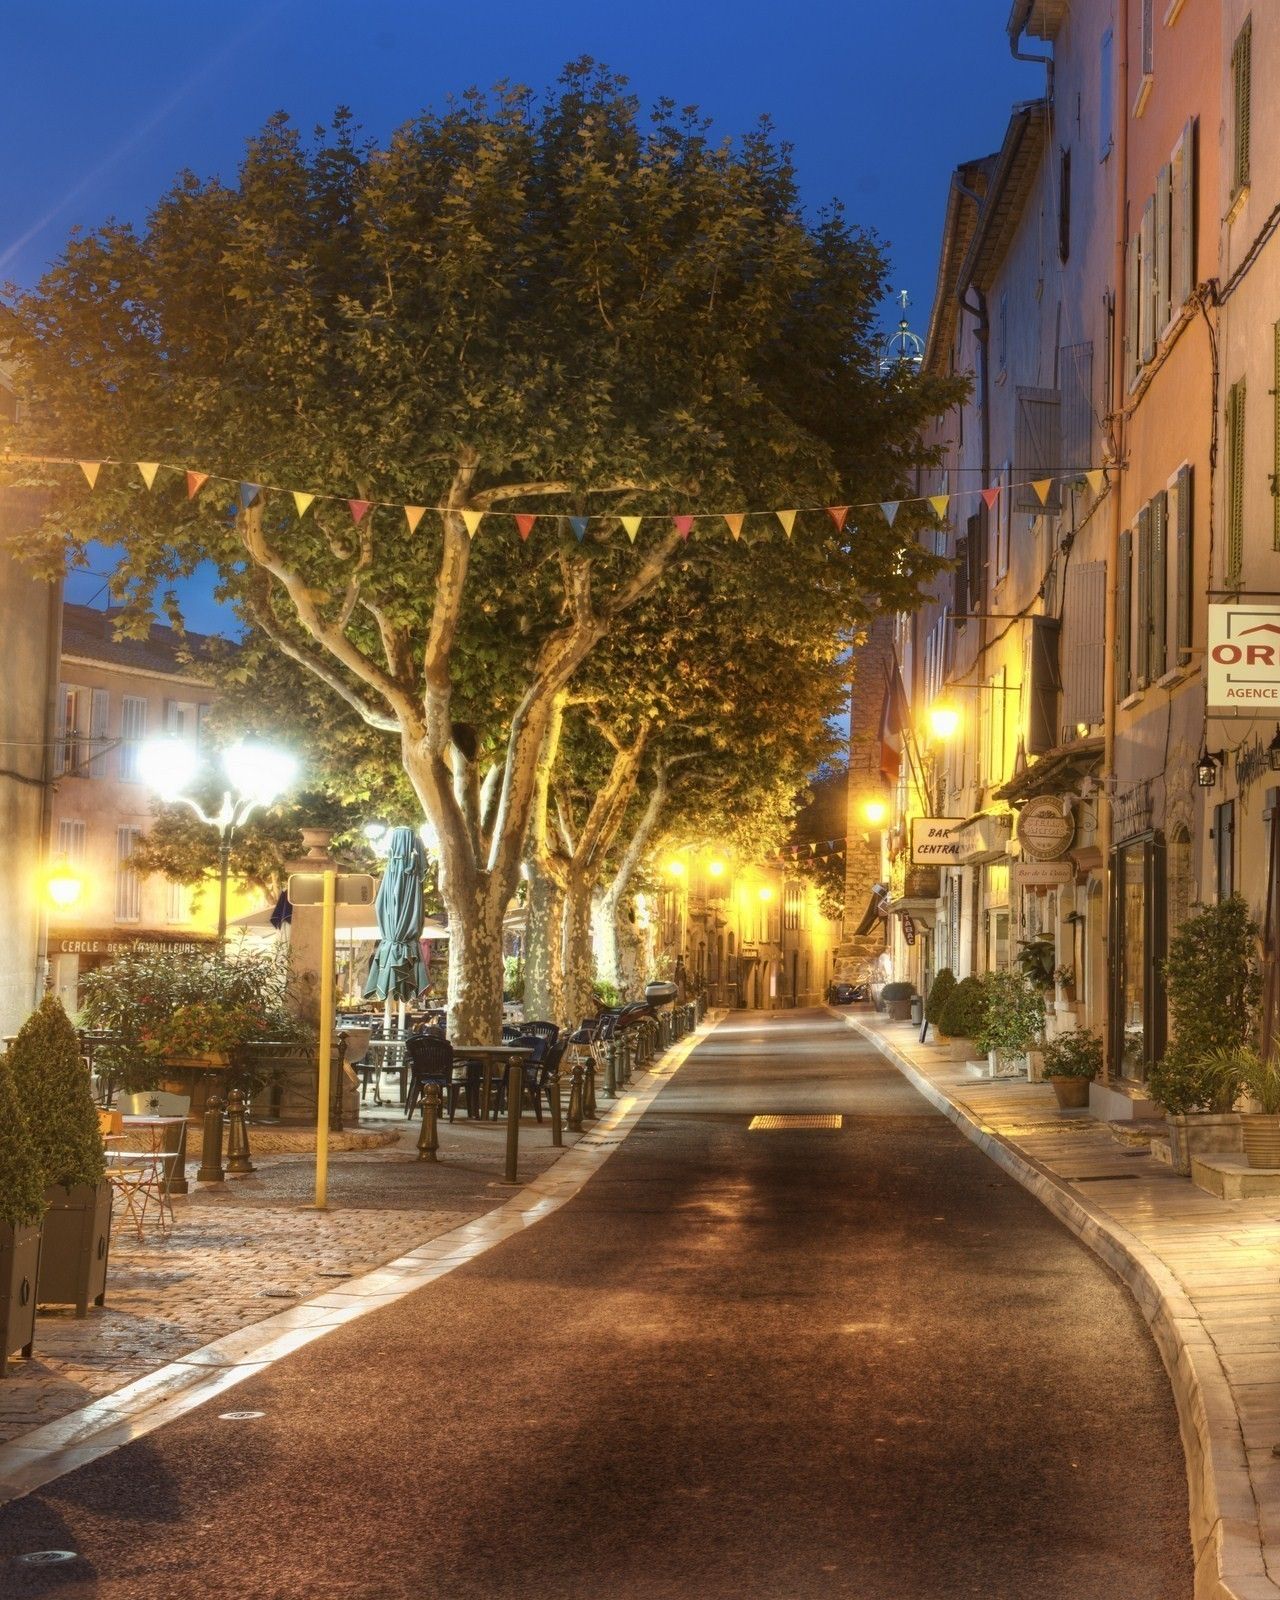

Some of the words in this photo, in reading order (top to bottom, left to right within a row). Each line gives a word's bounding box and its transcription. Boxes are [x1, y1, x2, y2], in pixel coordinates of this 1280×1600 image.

[1226, 687, 1279, 699] AGENCE
[928, 828, 951, 839] BAR
[917, 844, 960, 854] CENTRAL
[903, 914, 914, 945] TABAC
[61, 940, 99, 953] CERCLE
